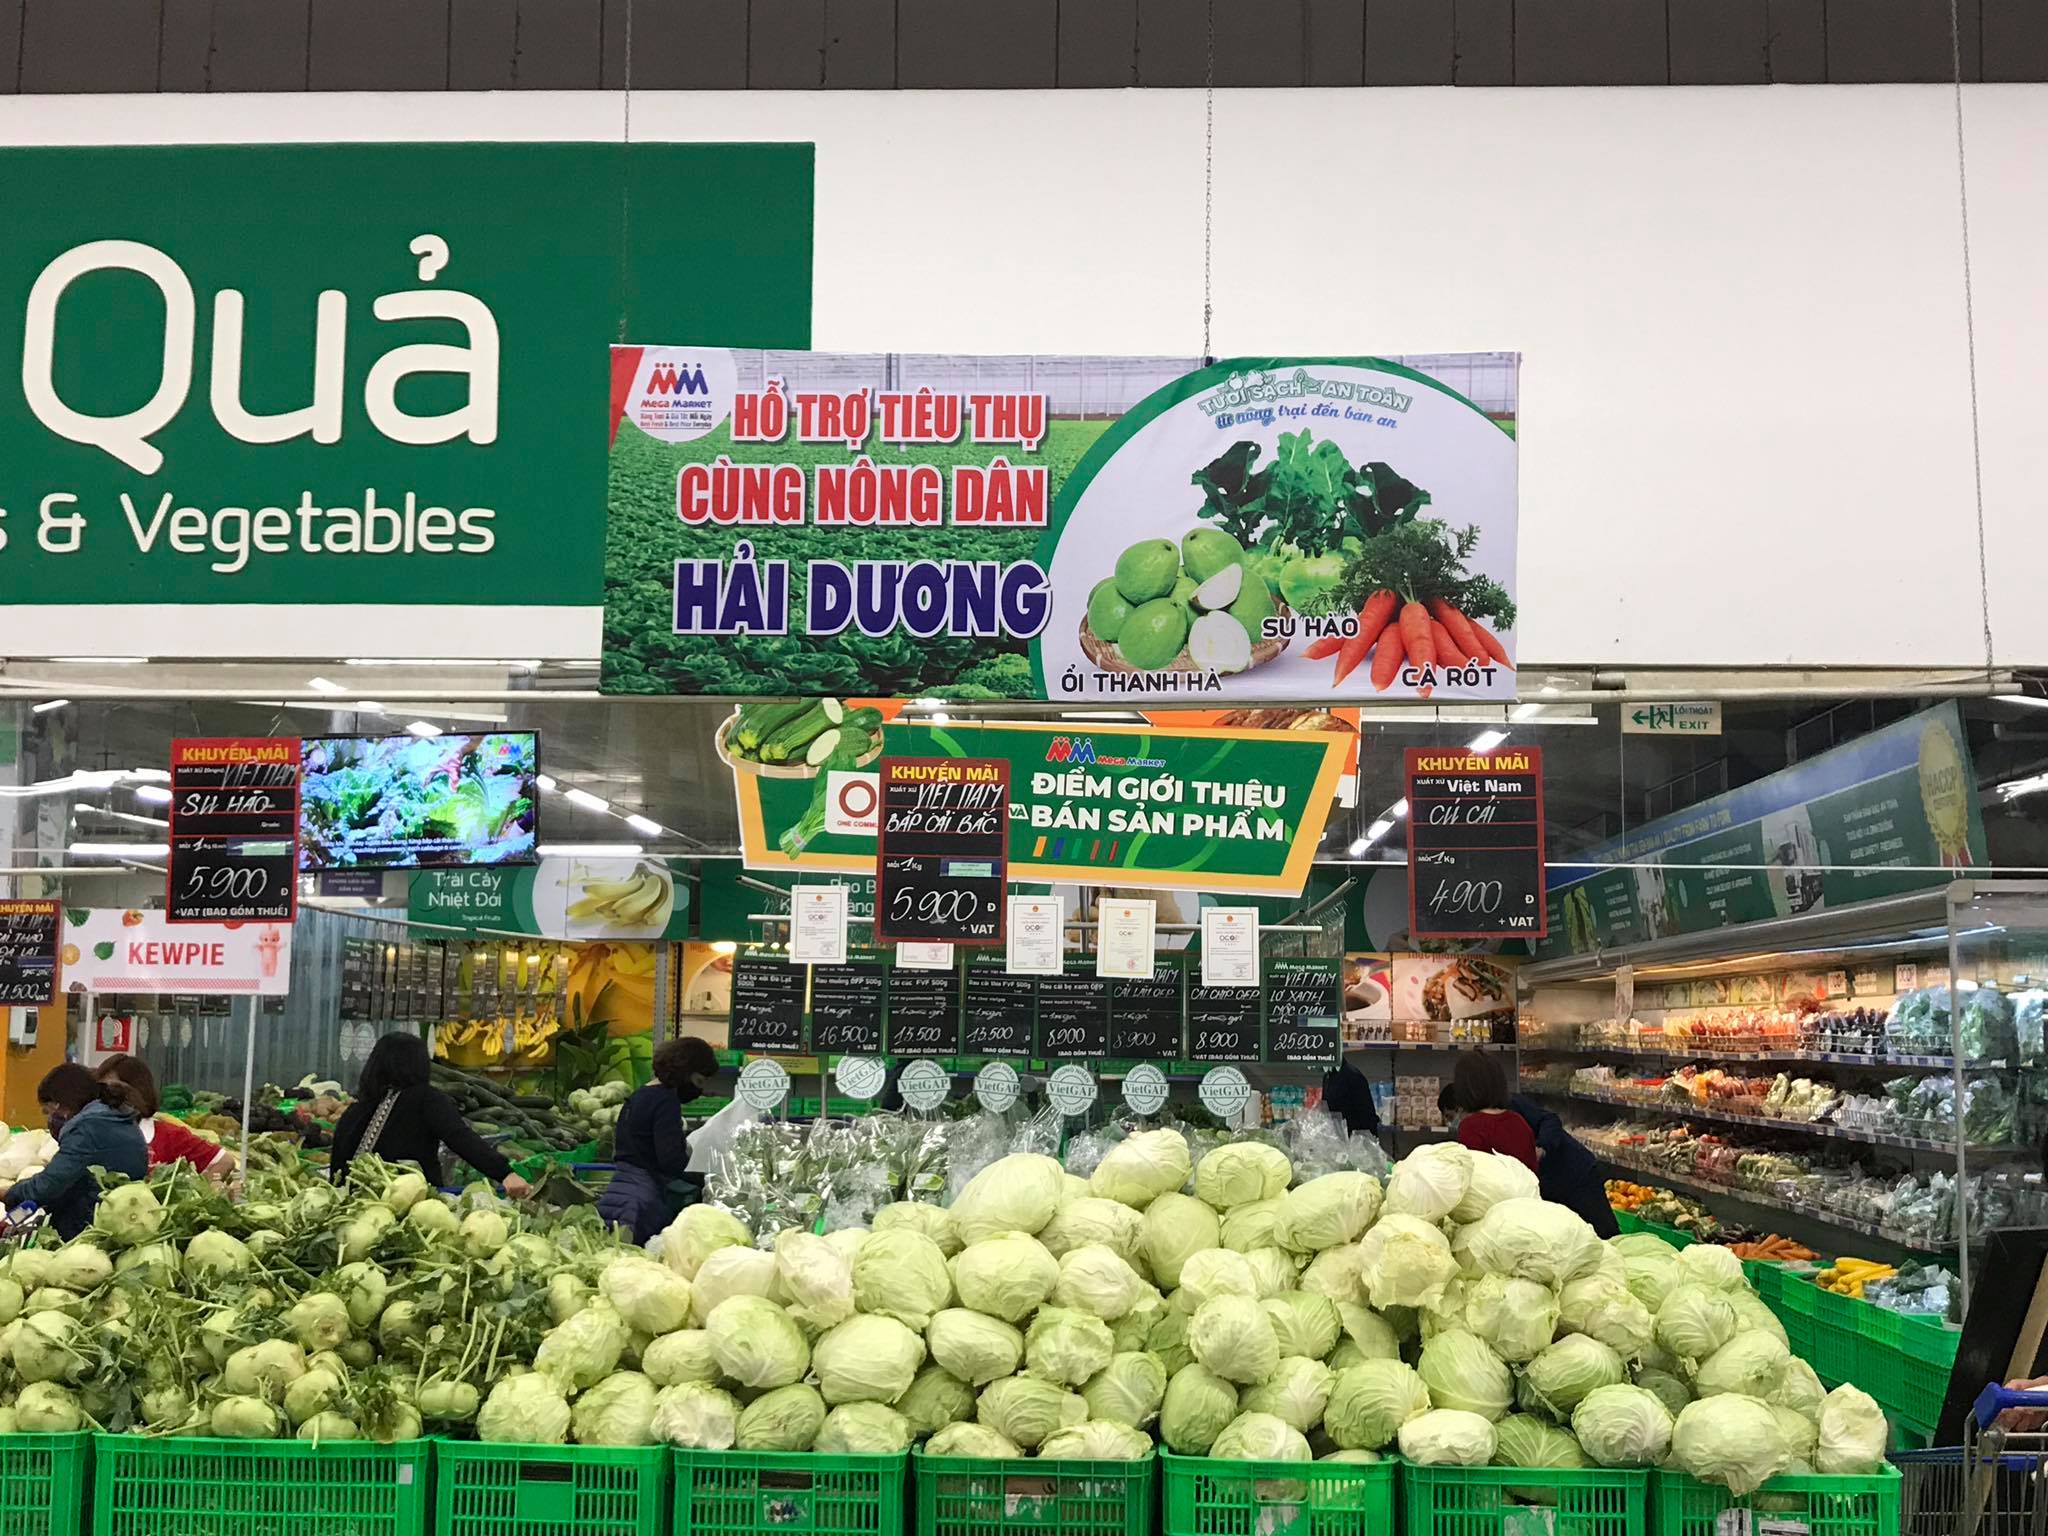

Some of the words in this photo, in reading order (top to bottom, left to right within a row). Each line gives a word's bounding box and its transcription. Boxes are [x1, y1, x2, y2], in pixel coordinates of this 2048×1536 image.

[22, 234, 500, 475] Quả
[1251, 379, 1305, 401] SẠCH
[1323, 382, 1352, 398] AN
[1357, 385, 1411, 412] TOÀN
[734, 378, 786, 438] HỖ
[797, 387, 870, 447] TRỢ
[880, 387, 960, 438] TIÊU
[970, 394, 1045, 448] THỤ
[1278, 403, 1307, 419] trại
[1312, 401, 1340, 417] đến
[680, 458, 803, 521] CÙNG
[818, 458, 940, 522] NÔNG
[955, 458, 1045, 522] DÂN
[37, 492, 86, 553] &
[120, 488, 496, 573] Vegetables
[677, 543, 787, 632] HẢI
[810, 560, 1049, 636] DƯƠNG
[1263, 618, 1295, 637] SU
[1306, 612, 1358, 637] HÀO
[1061, 663, 1084, 693] ỔI
[1094, 672, 1177, 693] THANH
[1186, 668, 1221, 692] HÀ
[1401, 664, 1437, 687] CÀ
[1446, 657, 1497, 687] RỐT
[1680, 721, 1709, 730] EXIT
[183, 743, 251, 761] KHUYẾN
[257, 744, 288, 760] MÃI
[1418, 752, 1489, 770] KHUYẾN
[1495, 754, 1529, 770] MÃI
[892, 761, 961, 781] KHUYẾN
[967, 764, 999, 780] MÃI
[1032, 767, 1113, 800] ĐIỂM
[1118, 772, 1186, 804] GIỚI
[1191, 779, 1286, 811] THIỆU
[1448, 779, 1480, 794] Việt
[1485, 780, 1522, 792] Nam
[1927, 766, 1959, 796] HACCP
[181, 793, 219, 816] SU
[1009, 805, 1026, 817] VÀ
[1032, 798, 1102, 829] BÁN
[1107, 804, 1179, 835] SẢN
[1184, 809, 1285, 842] PHẨM
[181, 866, 268, 900] 5.900
[469, 872, 502, 890] Cây
[428, 891, 470, 909] Nhiệt
[475, 892, 502, 907] Đới
[891, 887, 978, 922] 5.900
[1429, 879, 1502, 914] 4.900
[970, 924, 995, 933] VAT
[1509, 917, 1534, 926] VAT
[128, 942, 225, 966] KEWPIE
[735, 1018, 787, 1036] 22.000
[818, 1026, 868, 1045] 16.500
[1113, 1031, 1156, 1048] 8.900
[1196, 1032, 1239, 1050] 8.900
[739, 1078, 788, 1090] VietGAP
[899, 1079, 949, 1091] VietGAP
[976, 1080, 1020, 1094] VietGAP
[1049, 1083, 1097, 1097] VietGAP
[1125, 1083, 1167, 1095] VietGAP
[1201, 1084, 1249, 1097] VietGAP
